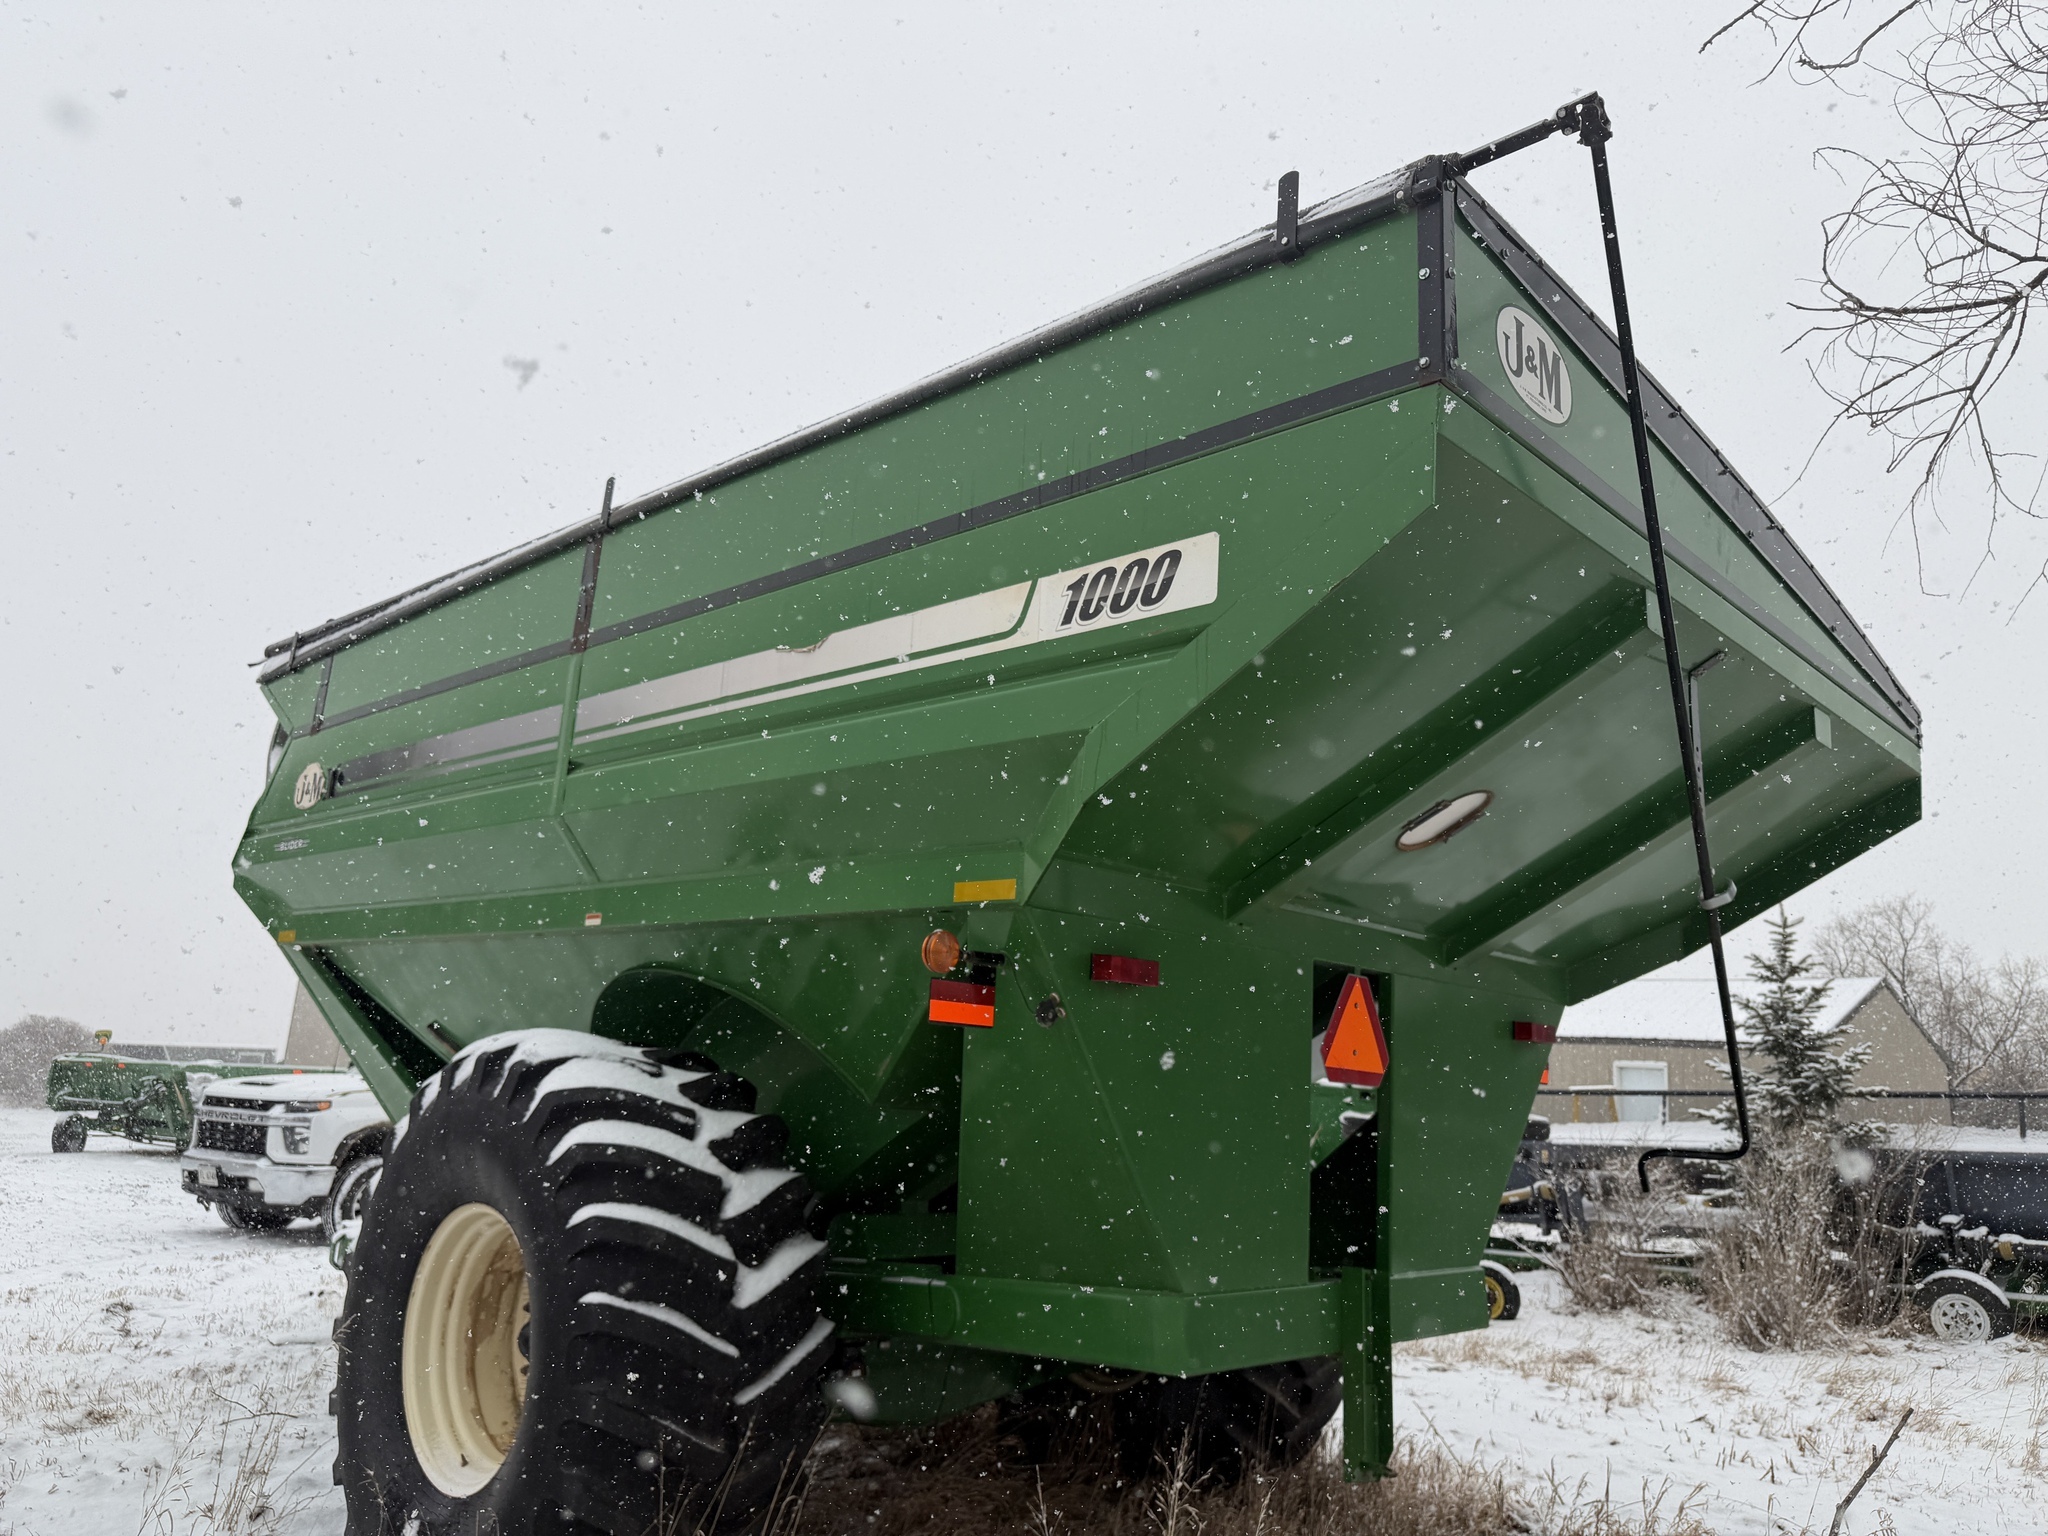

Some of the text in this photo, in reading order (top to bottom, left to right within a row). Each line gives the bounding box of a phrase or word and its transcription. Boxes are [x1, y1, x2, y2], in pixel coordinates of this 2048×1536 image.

[1503, 316, 1563, 415] J&M
[1058, 549, 1182, 629] 1000
[297, 773, 323, 805] J&M
[195, 1109, 264, 1123] CHEVROLET
